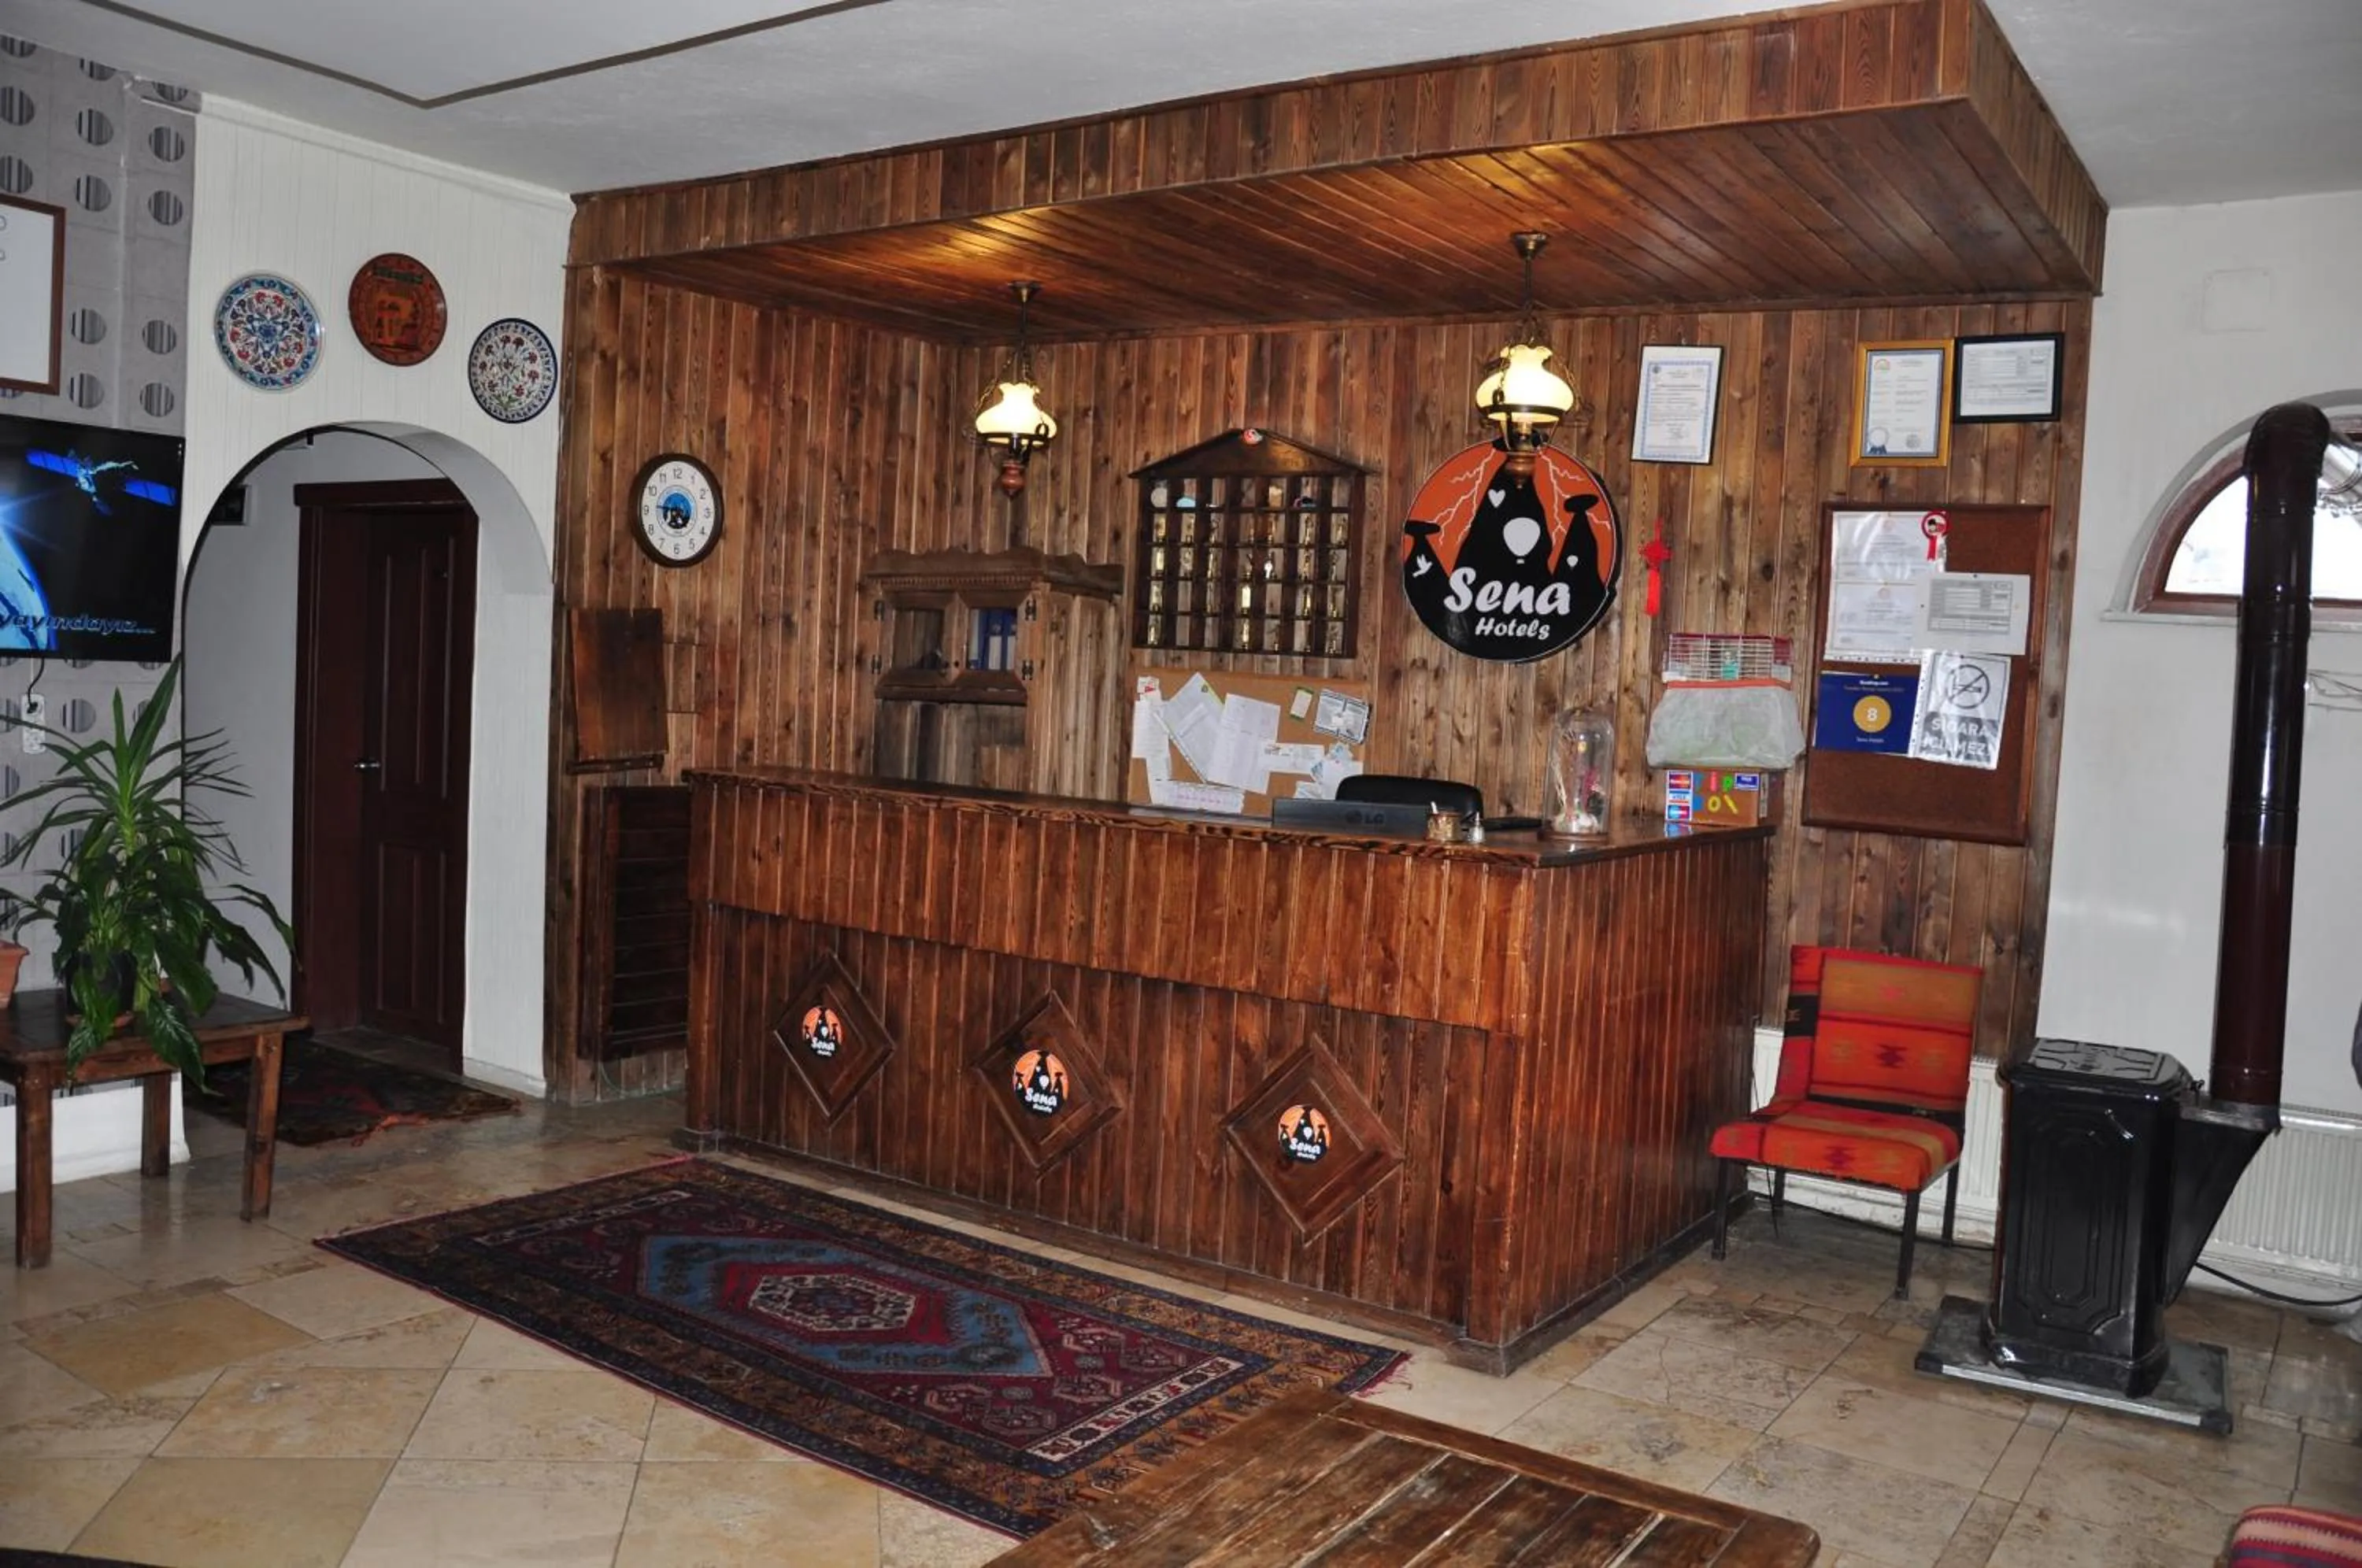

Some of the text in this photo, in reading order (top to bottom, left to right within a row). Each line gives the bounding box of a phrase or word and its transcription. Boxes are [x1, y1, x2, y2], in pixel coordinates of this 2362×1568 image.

[659, 472, 667, 483] 11
[673, 468, 683, 479] 12
[690, 475, 695, 484] 1
[648, 485, 657, 497] 10
[699, 488, 706, 500] 2
[643, 505, 650, 516] 9
[704, 507, 712, 519] 3
[648, 523, 654, 535] 8
[699, 525, 706, 535] 4
[658, 537, 665, 549] 7
[673, 543, 680, 555] 6
[688, 538, 695, 549] 5
[1443, 566, 1571, 616] Sena
[1475, 616, 1550, 640] Hotels
[1867, 707, 1878, 722] 8
[1364, 812, 1385, 824] LG
[1024, 1087, 1057, 1107] Sena
[1289, 1137, 1320, 1155] Sena
